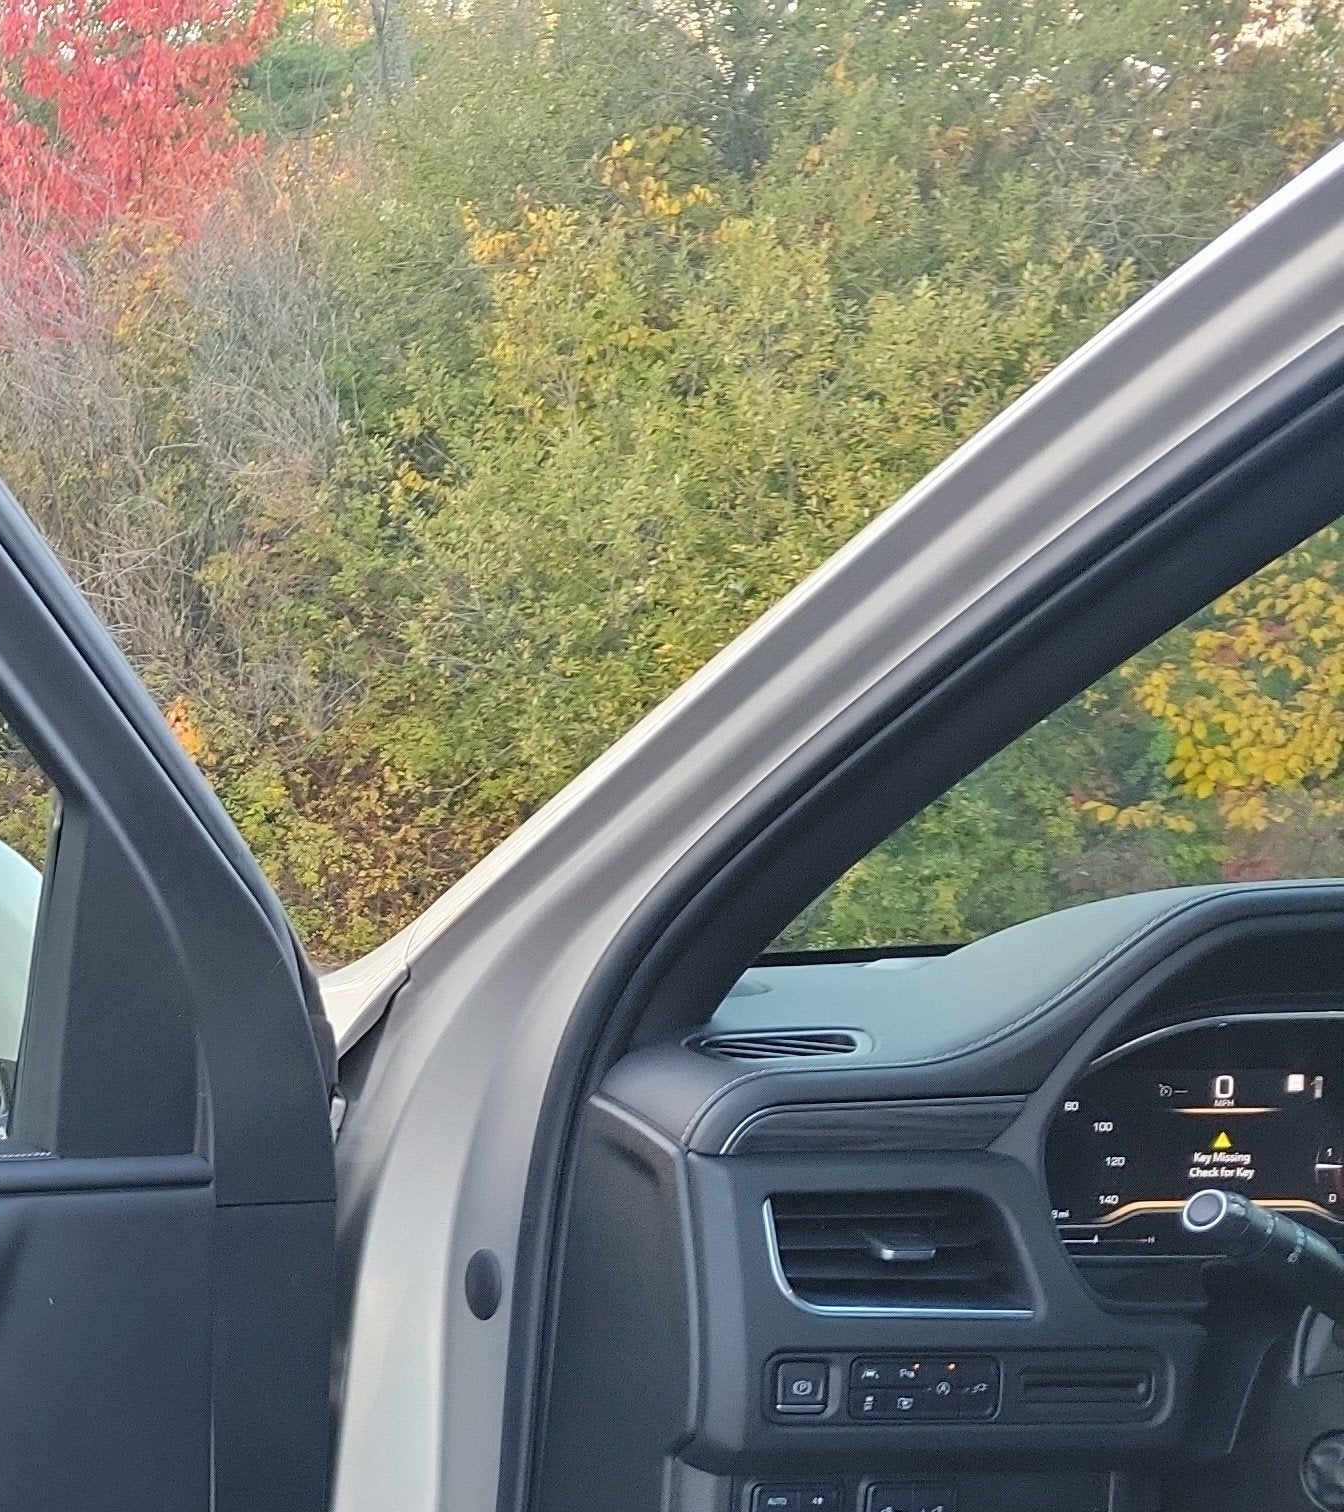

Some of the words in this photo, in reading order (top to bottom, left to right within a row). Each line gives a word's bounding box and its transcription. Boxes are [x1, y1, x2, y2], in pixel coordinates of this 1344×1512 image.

[1215, 1075, 1234, 1099] 0
[1064, 1101, 1079, 1111] 80
[1214, 1099, 1235, 1107] MPH
[1093, 1122, 1113, 1132] 100
[1105, 1156, 1125, 1167] 120
[1193, 1152, 1212, 1165] Key
[1213, 1152, 1252, 1165] Missing
[1189, 1166, 1220, 1177] Check
[1220, 1166, 1236, 1177] for
[1236, 1166, 1255, 1180] Key
[1098, 1195, 1119, 1204] 140
[1328, 1193, 1337, 1202] 0
